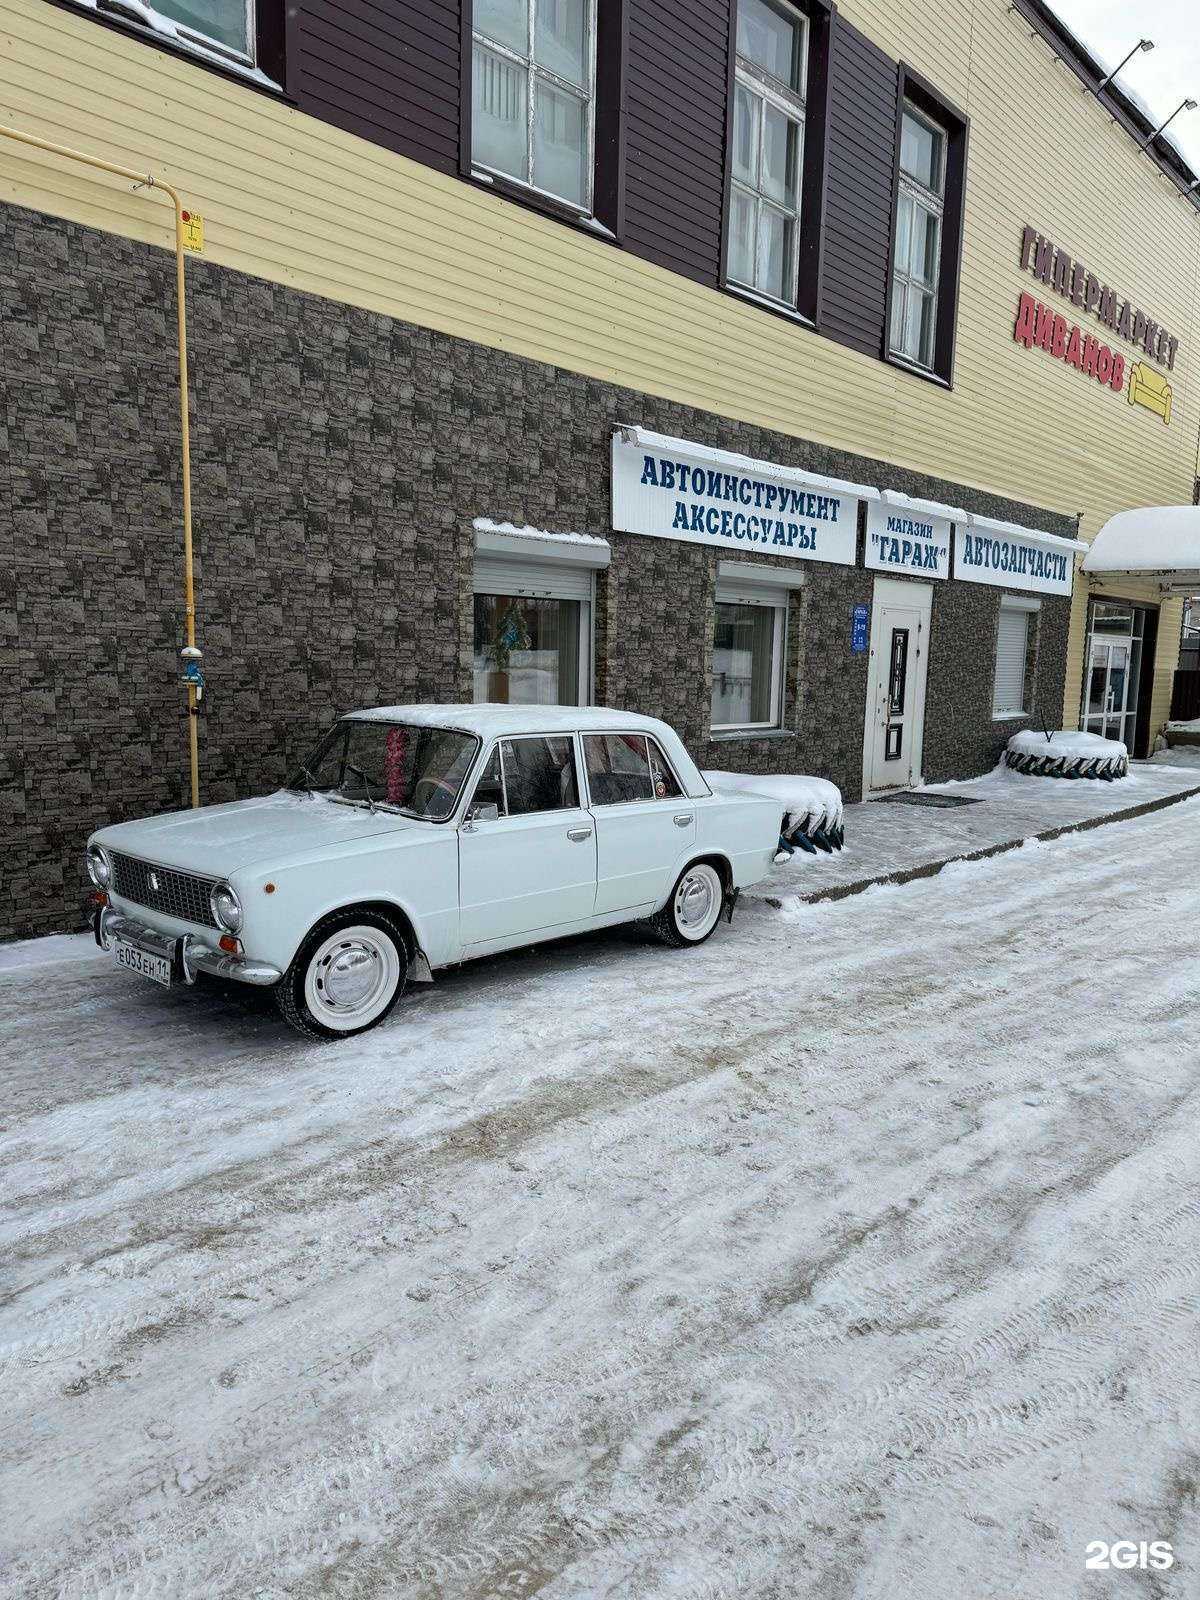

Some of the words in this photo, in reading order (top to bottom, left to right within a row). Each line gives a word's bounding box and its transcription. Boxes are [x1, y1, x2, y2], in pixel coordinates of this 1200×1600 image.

[1020, 225, 1179, 371] ГИПЕРМАРКЕТ
[1014, 291, 1125, 392] ДИВАНОВ
[641, 455, 840, 522] АВТОИНСТРУМЕНТ
[672, 501, 817, 550] АКСЕССУАРЫ
[887, 516, 933, 539] МАГАЗИН
[871, 533, 946, 571] "ГАРАЖ"
[963, 534, 1067, 581] АВТОЗАПЧАСТИ
